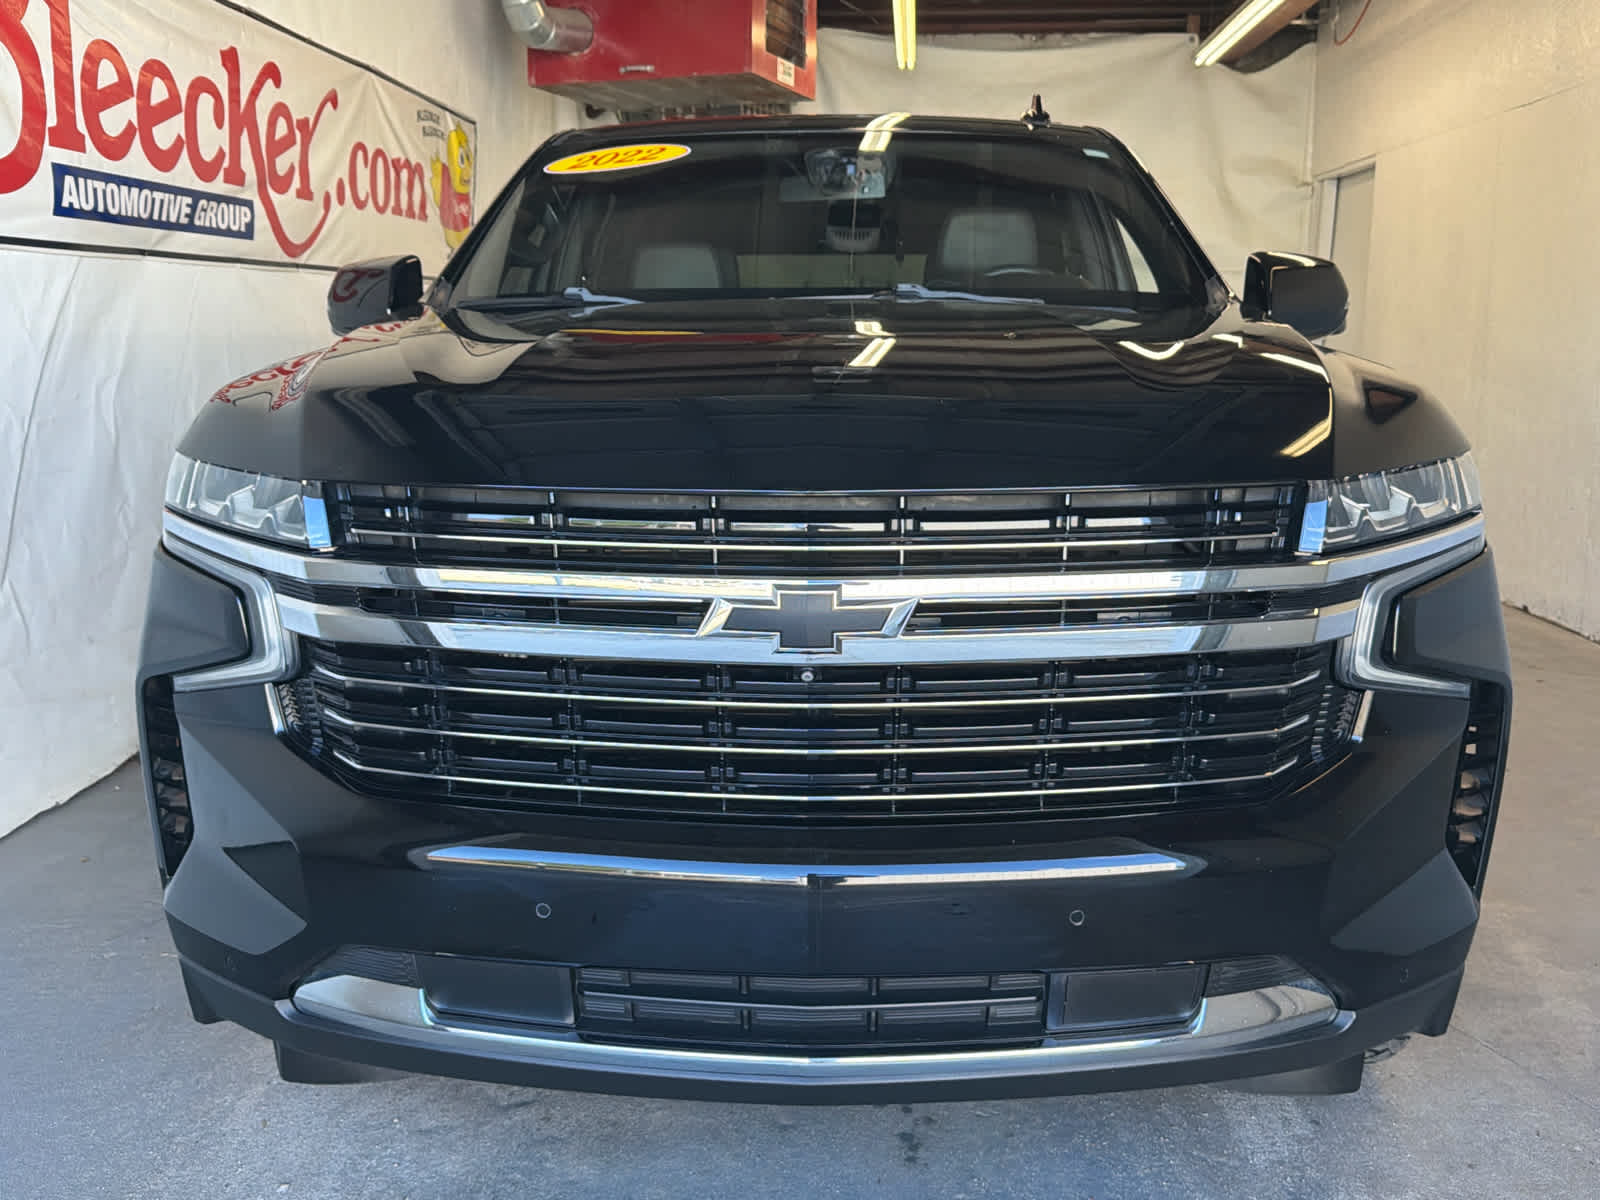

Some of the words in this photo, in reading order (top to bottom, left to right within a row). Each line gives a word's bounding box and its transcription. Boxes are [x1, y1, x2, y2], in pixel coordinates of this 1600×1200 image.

[567, 147, 667, 170] 2022
[61, 174, 192, 225] AUTOMOTIVE
[193, 199, 251, 233] GROUP
